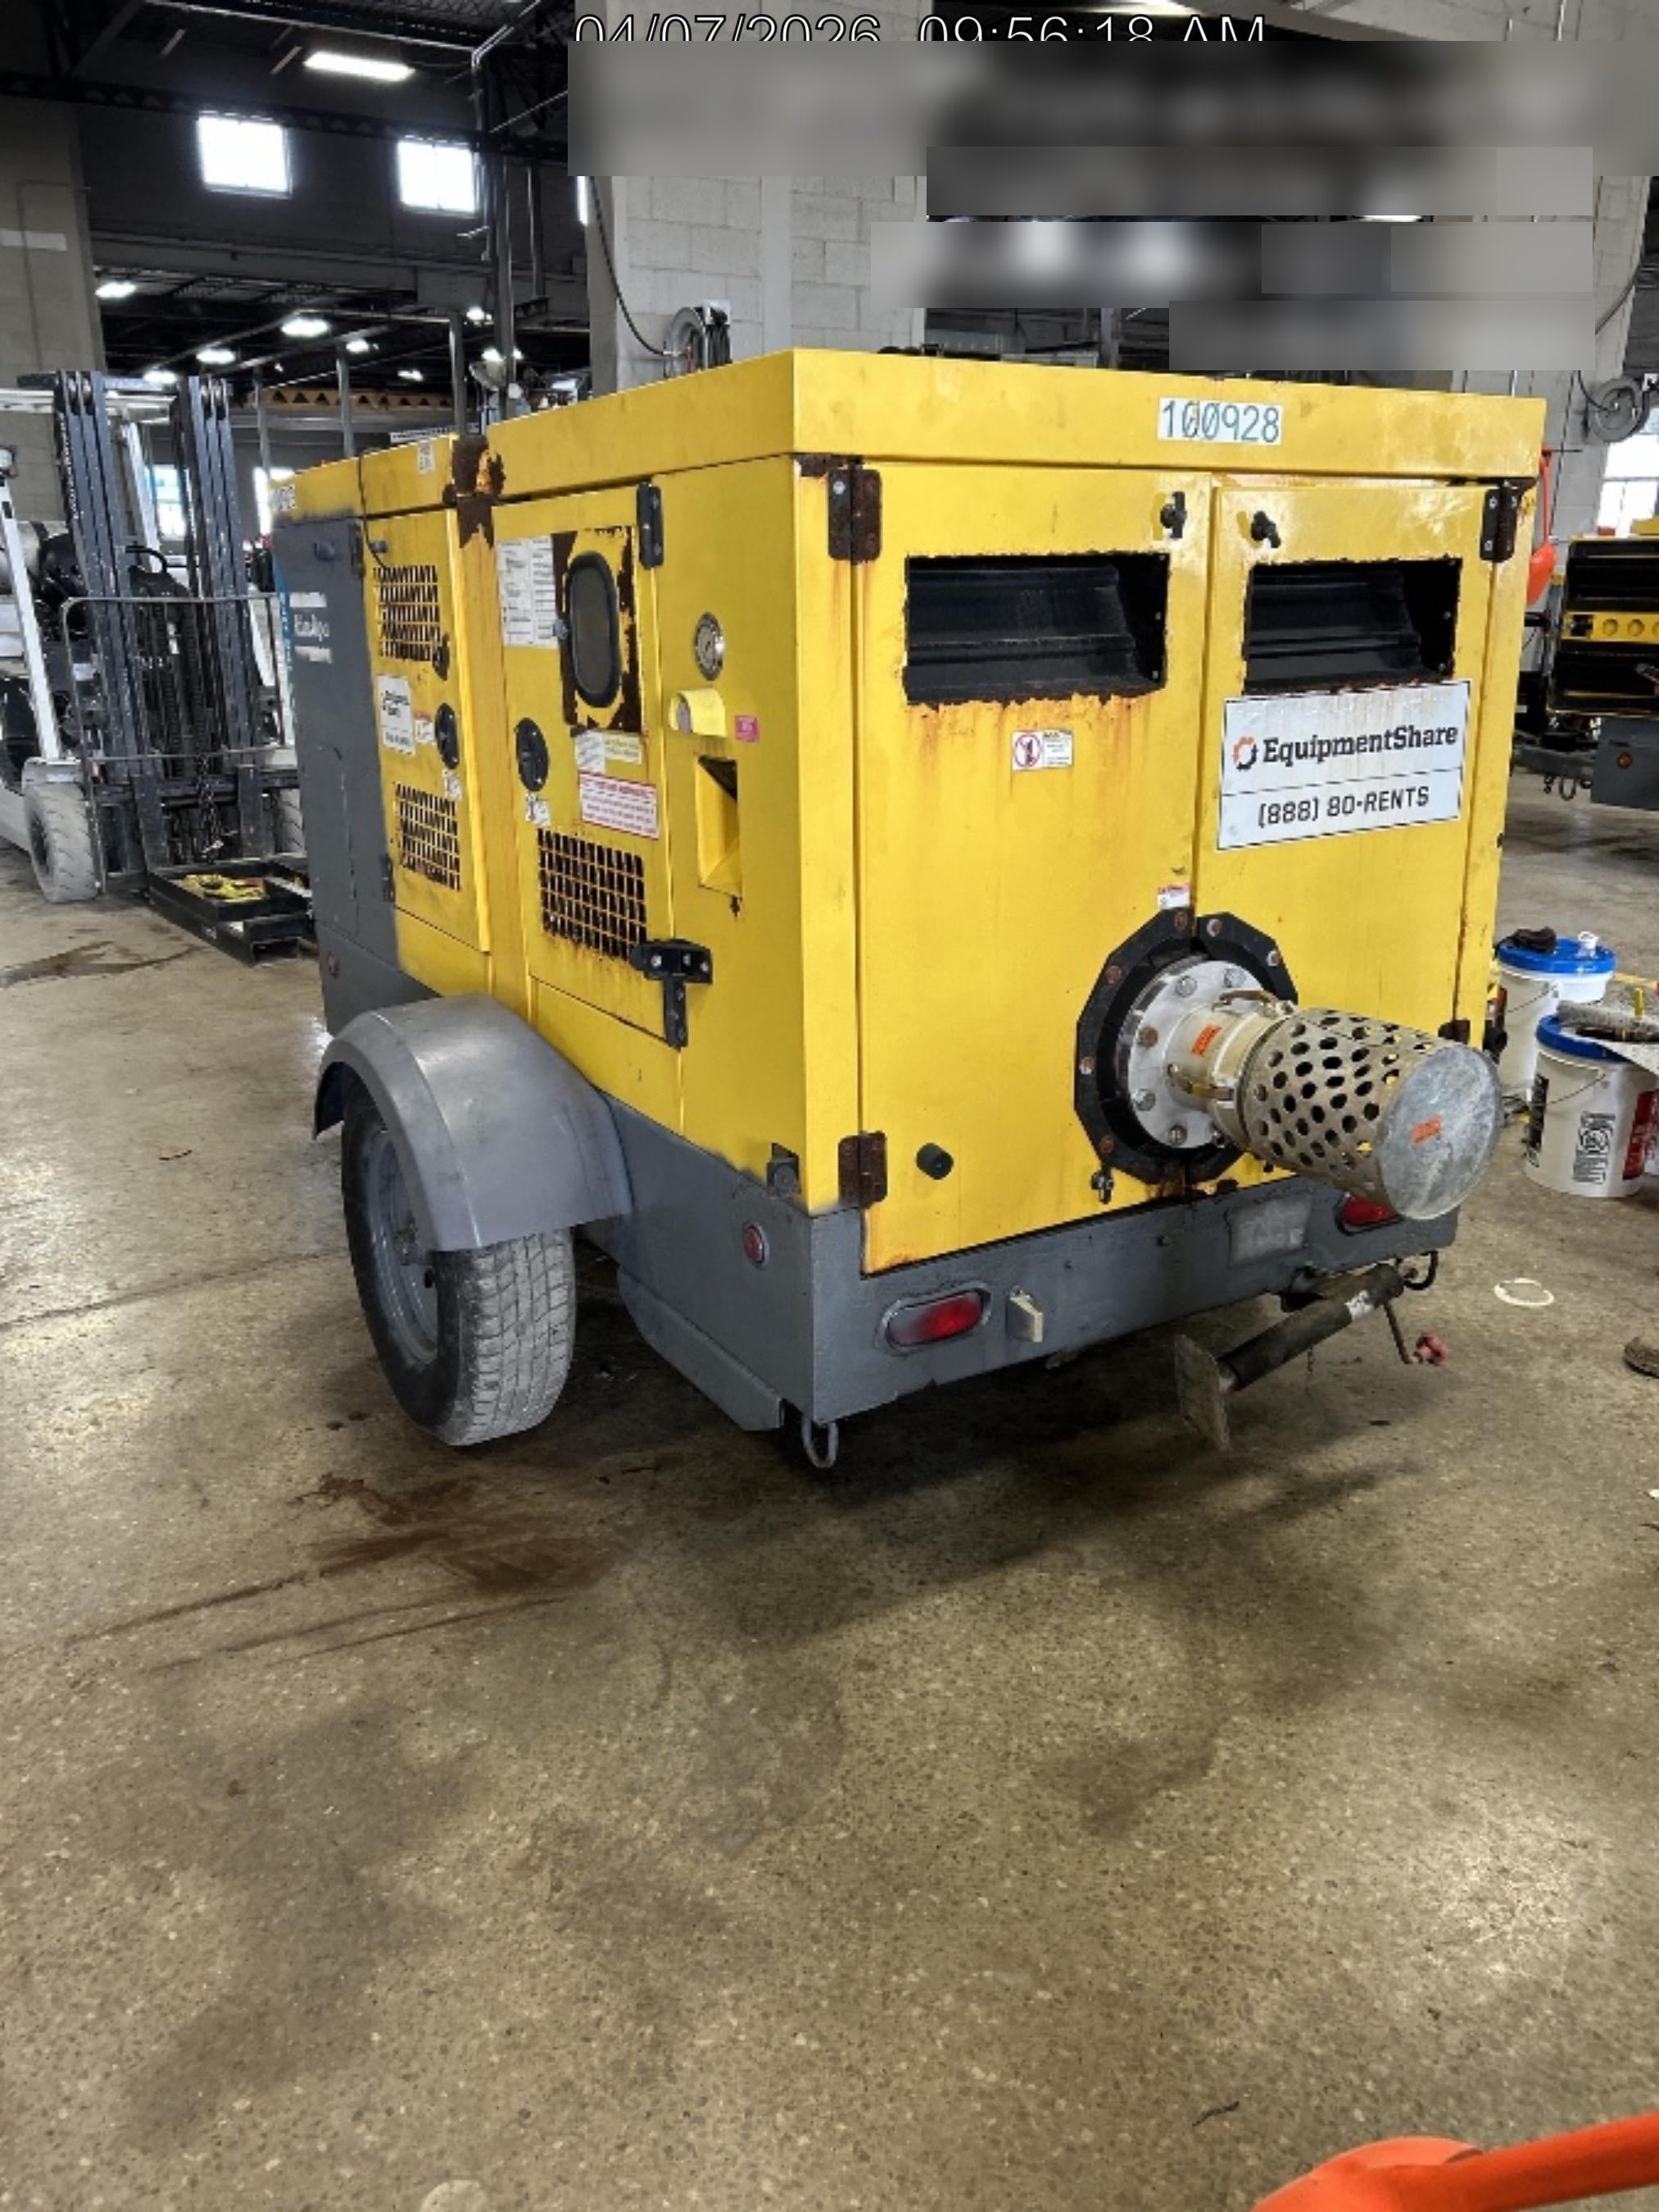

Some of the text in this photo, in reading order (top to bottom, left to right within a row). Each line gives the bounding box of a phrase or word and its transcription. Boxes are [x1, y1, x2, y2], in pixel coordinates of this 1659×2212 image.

[1162, 399, 1280, 443] 100928
[1262, 724, 1458, 767] EquipmentShare
[1258, 786, 1430, 828] (888) 80-RENTS
